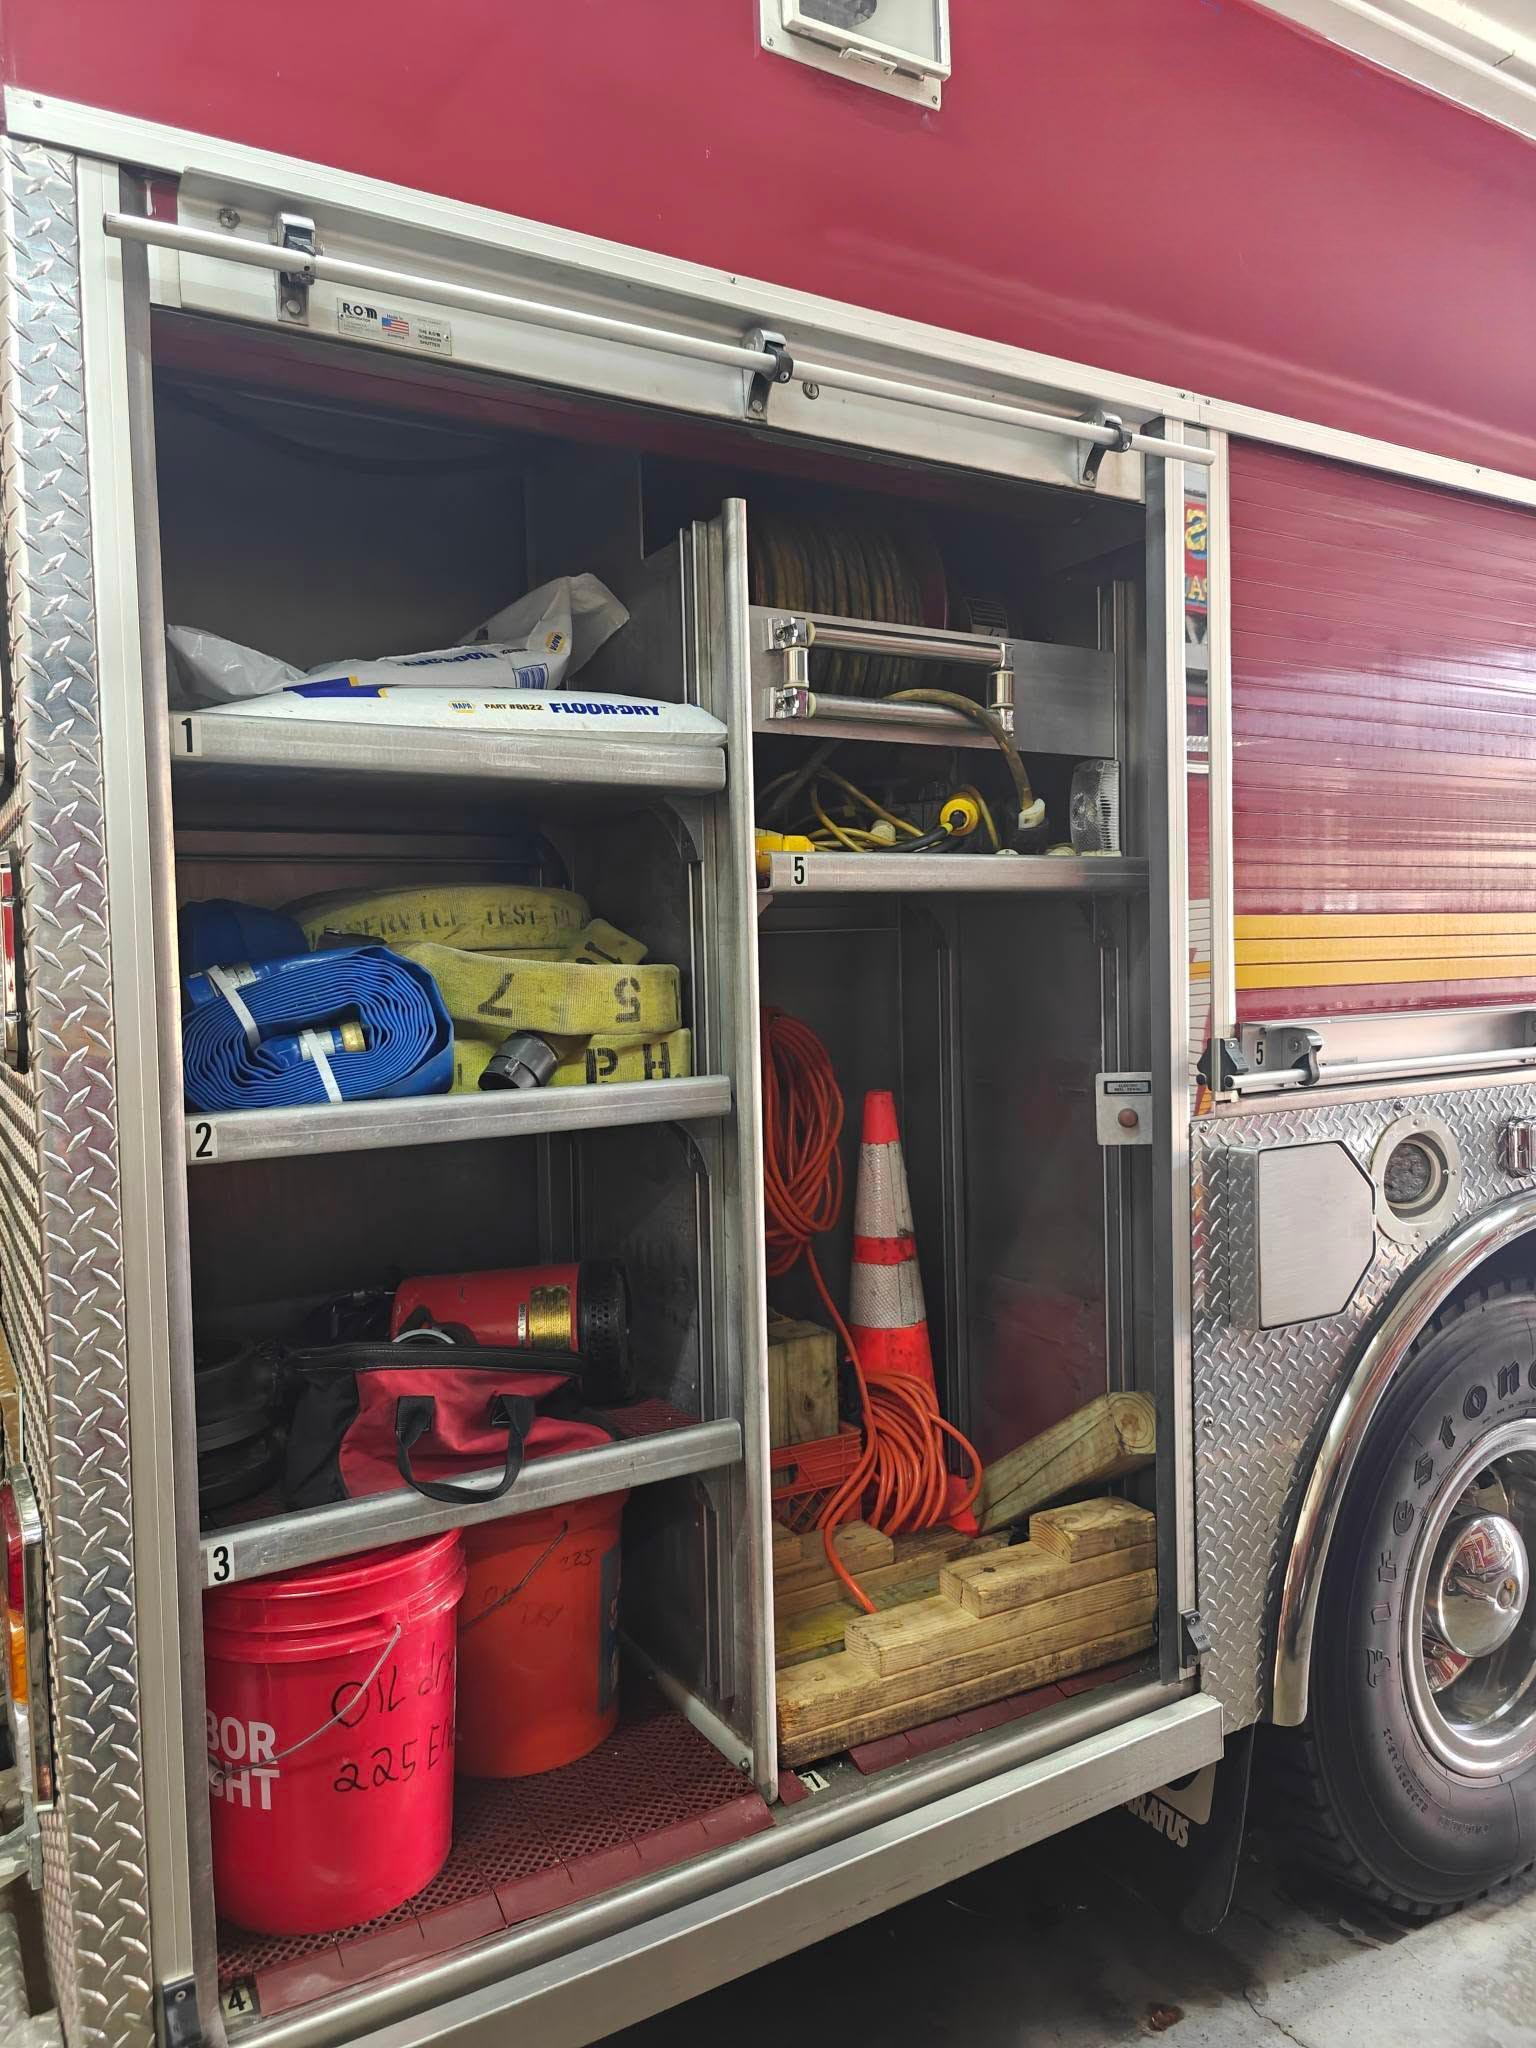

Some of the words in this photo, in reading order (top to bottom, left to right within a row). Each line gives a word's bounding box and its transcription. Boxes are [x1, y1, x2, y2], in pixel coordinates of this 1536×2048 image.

[451, 702, 472, 710] NAPA
[181, 717, 193, 753] 1
[794, 856, 805, 885] 5
[1255, 1041, 1264, 1065] 5
[195, 1122, 213, 1158] 2
[213, 1545, 230, 1582] 3
[333, 1738, 419, 1793] 225
[228, 1987, 247, 2011] 4
